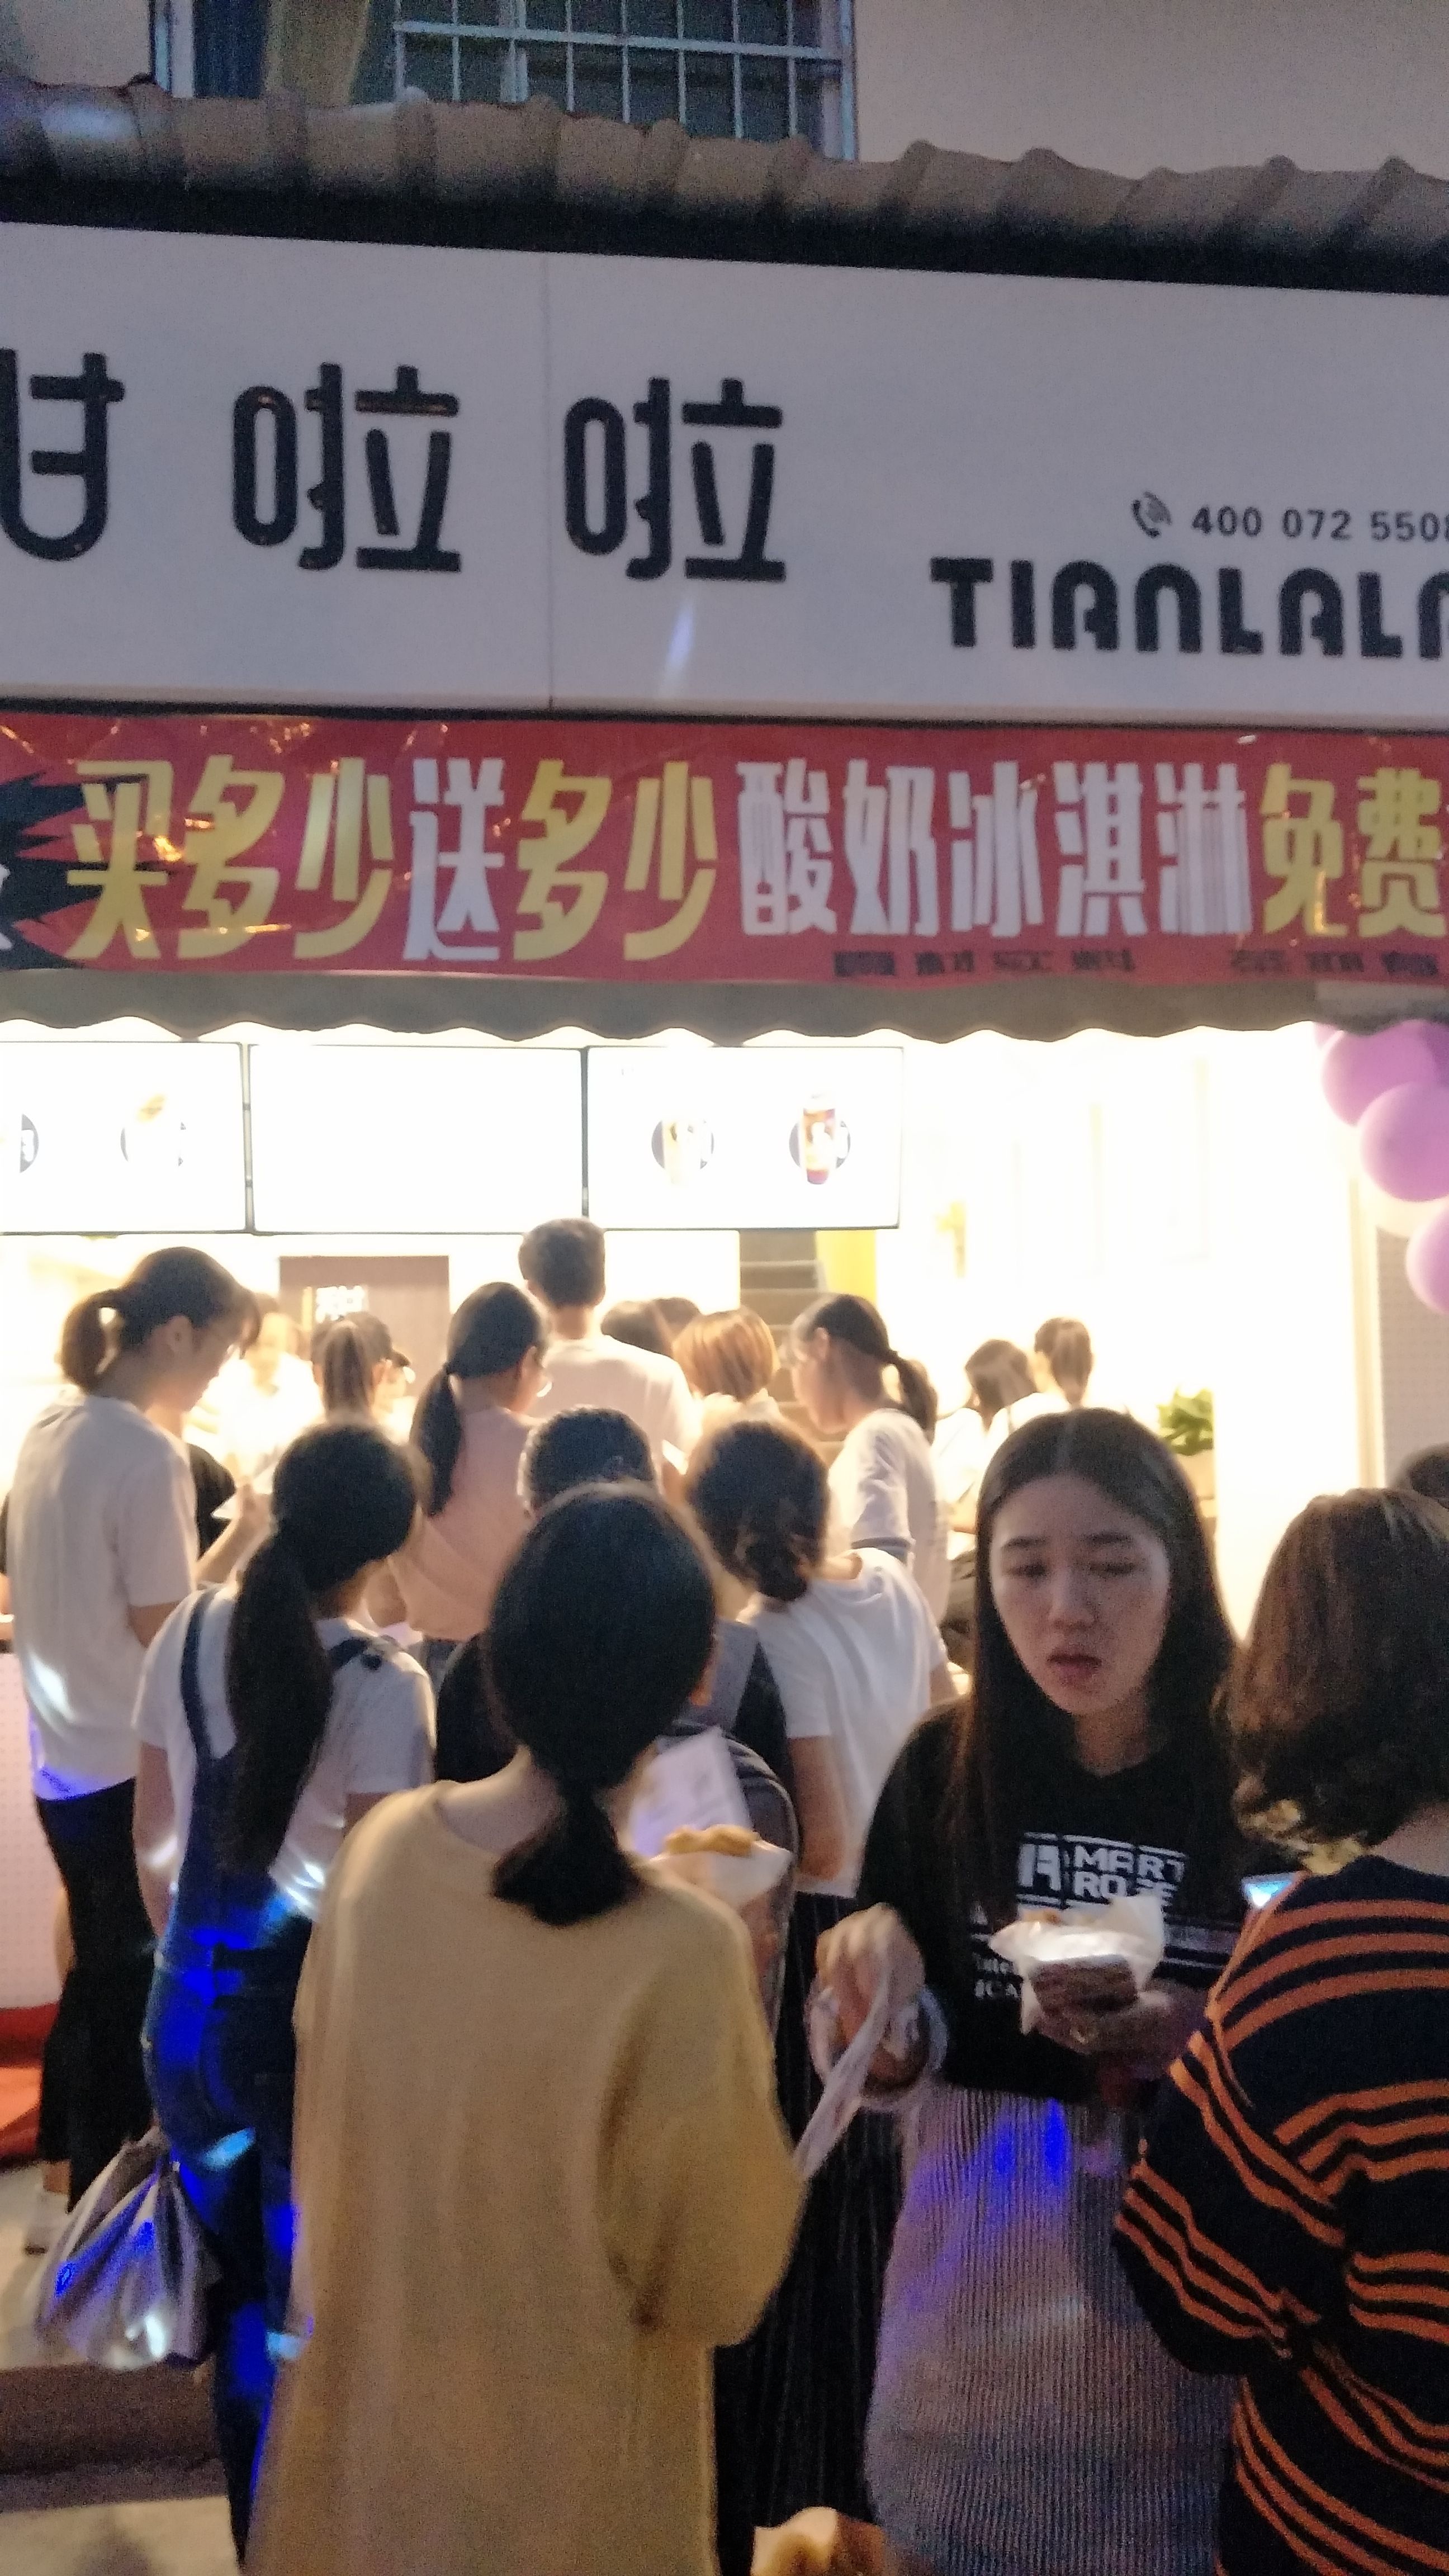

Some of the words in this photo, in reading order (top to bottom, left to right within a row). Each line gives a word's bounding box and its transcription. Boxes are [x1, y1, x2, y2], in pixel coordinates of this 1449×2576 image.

[1191, 505, 1263, 538] 400
[1281, 508, 1352, 541] 072
[1370, 510, 1449, 543] 550
